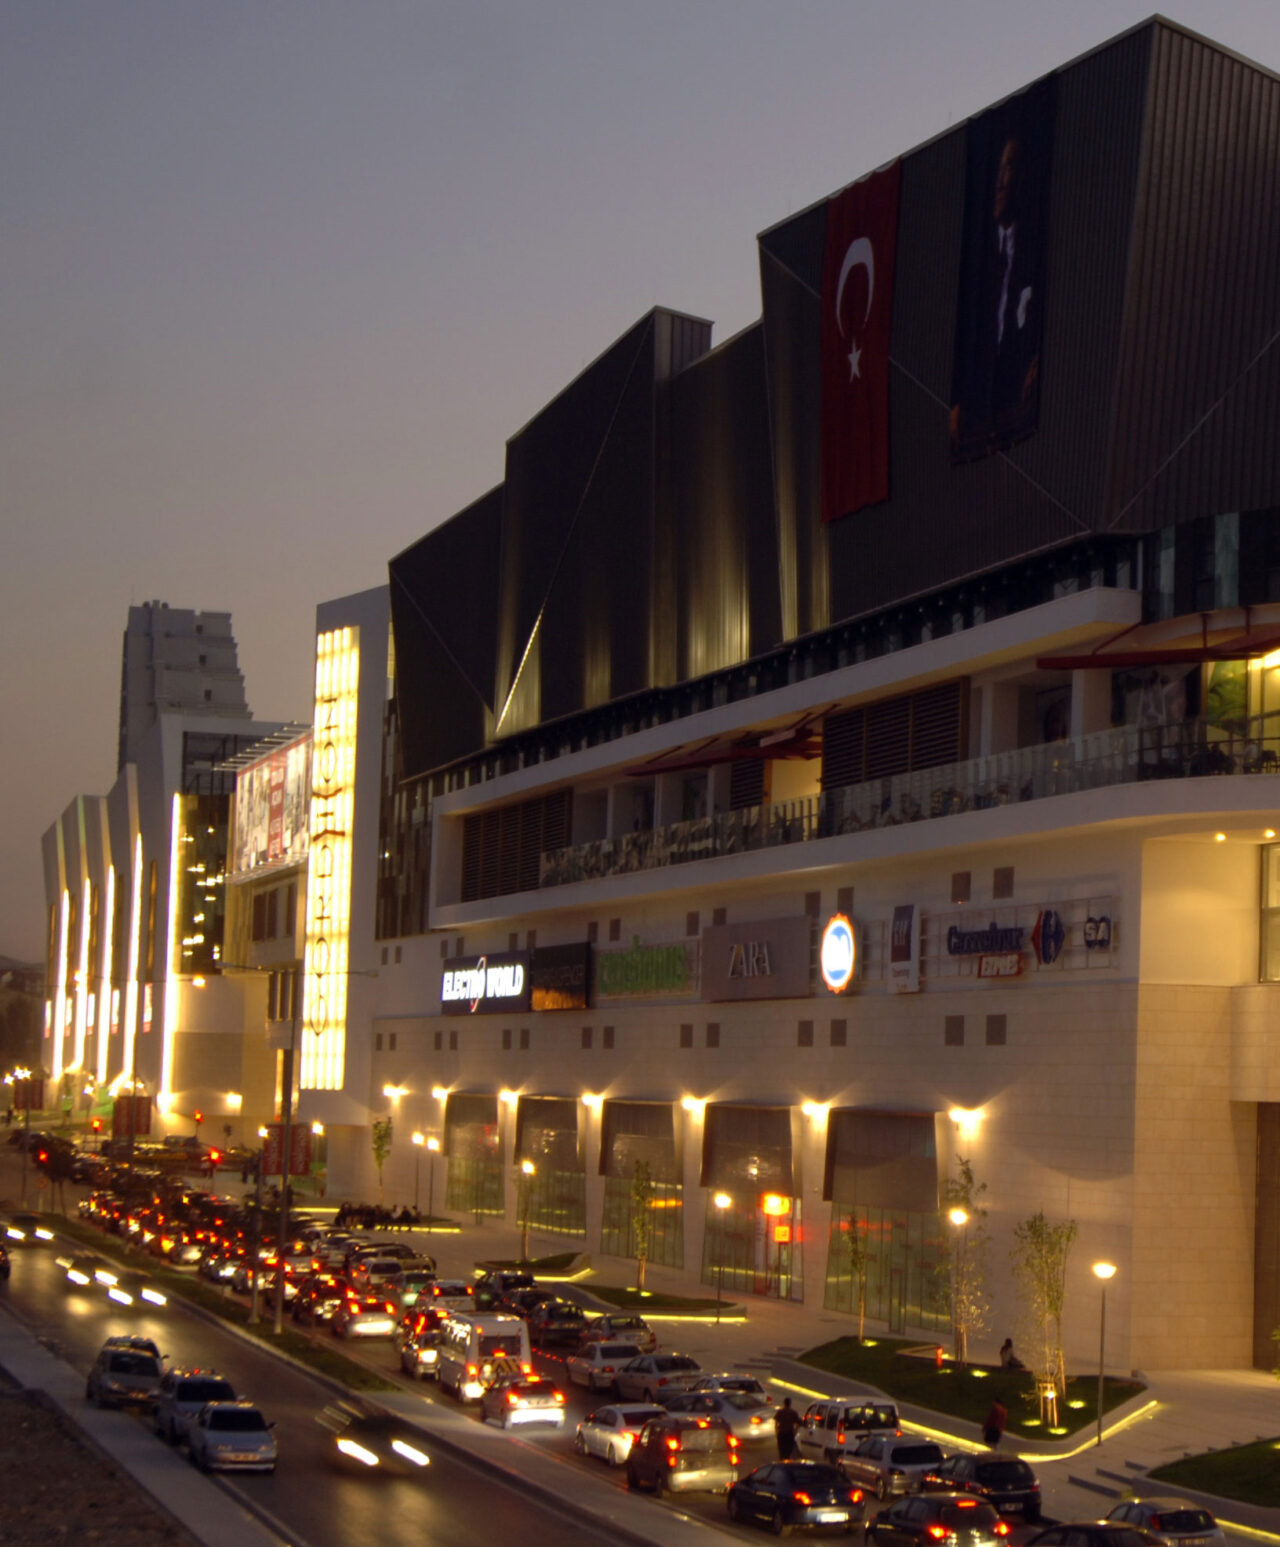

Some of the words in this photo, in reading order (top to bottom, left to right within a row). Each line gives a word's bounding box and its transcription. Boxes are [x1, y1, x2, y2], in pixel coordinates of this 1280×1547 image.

[310, 696, 340, 1037] GORDION
[728, 941, 770, 978] ZARA
[441, 967, 486, 1002] ELECTRO
[486, 964, 525, 999] WORLD
